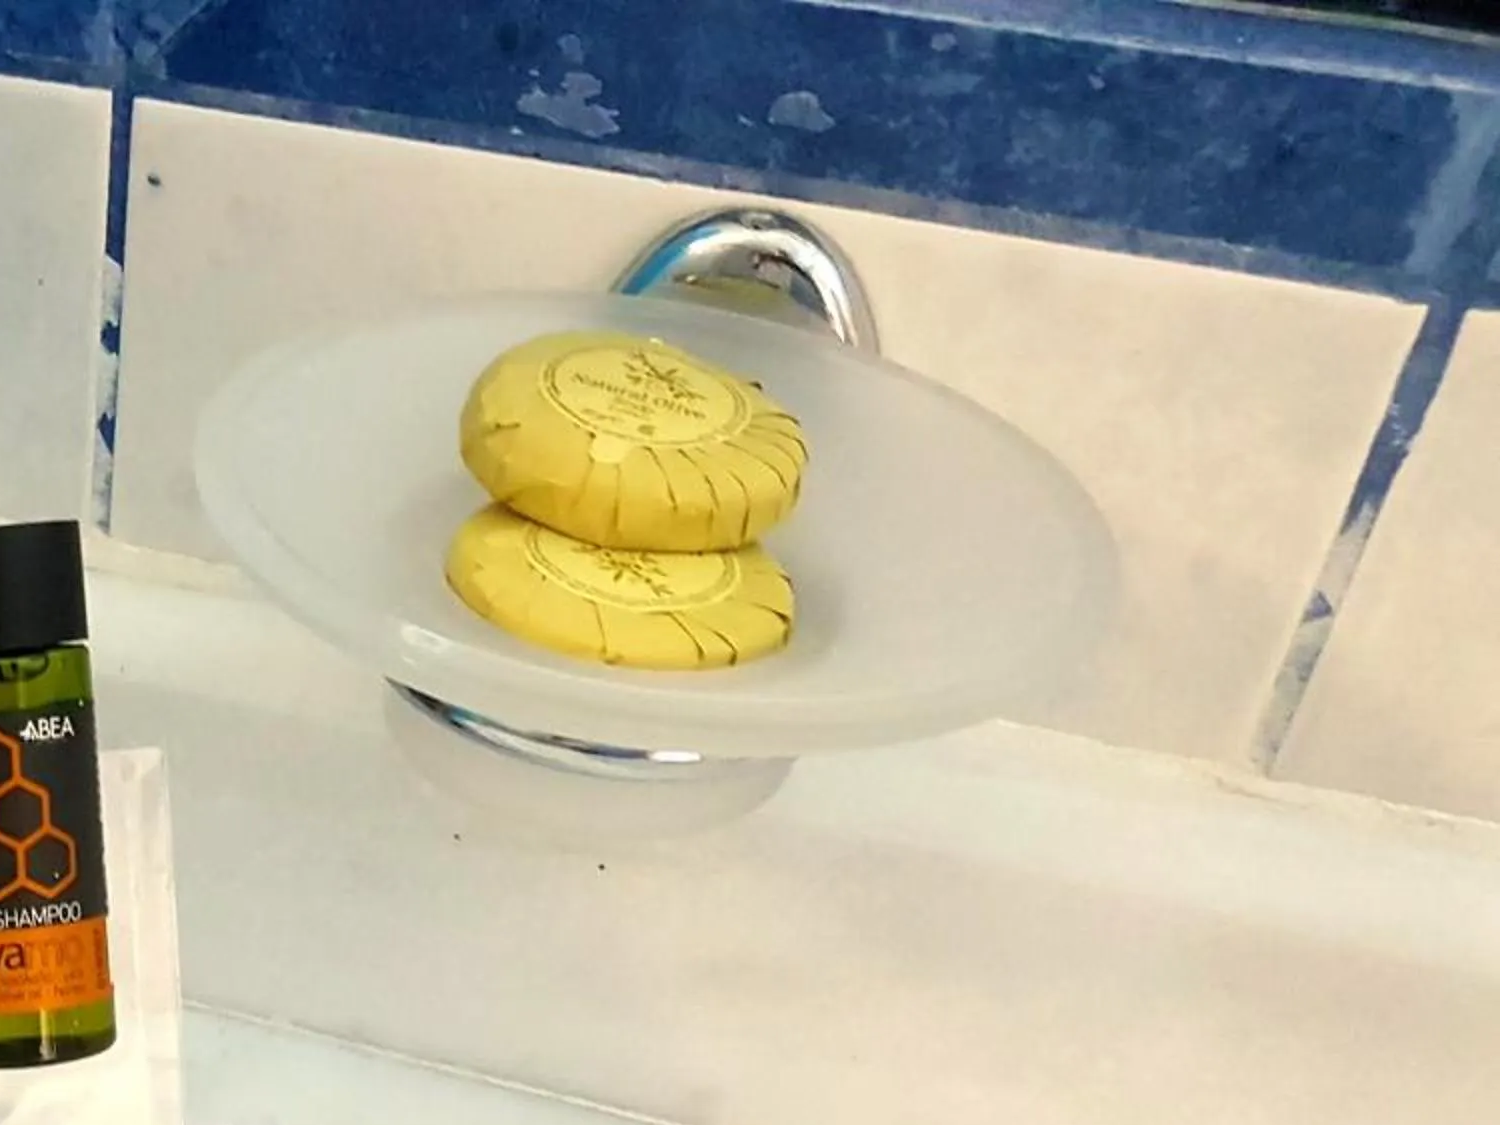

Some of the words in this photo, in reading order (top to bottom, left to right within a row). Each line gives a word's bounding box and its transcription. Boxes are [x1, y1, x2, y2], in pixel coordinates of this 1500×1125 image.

[571, 371, 649, 401] Natural
[652, 397, 707, 420] Olive
[19, 715, 75, 742] ABEA
